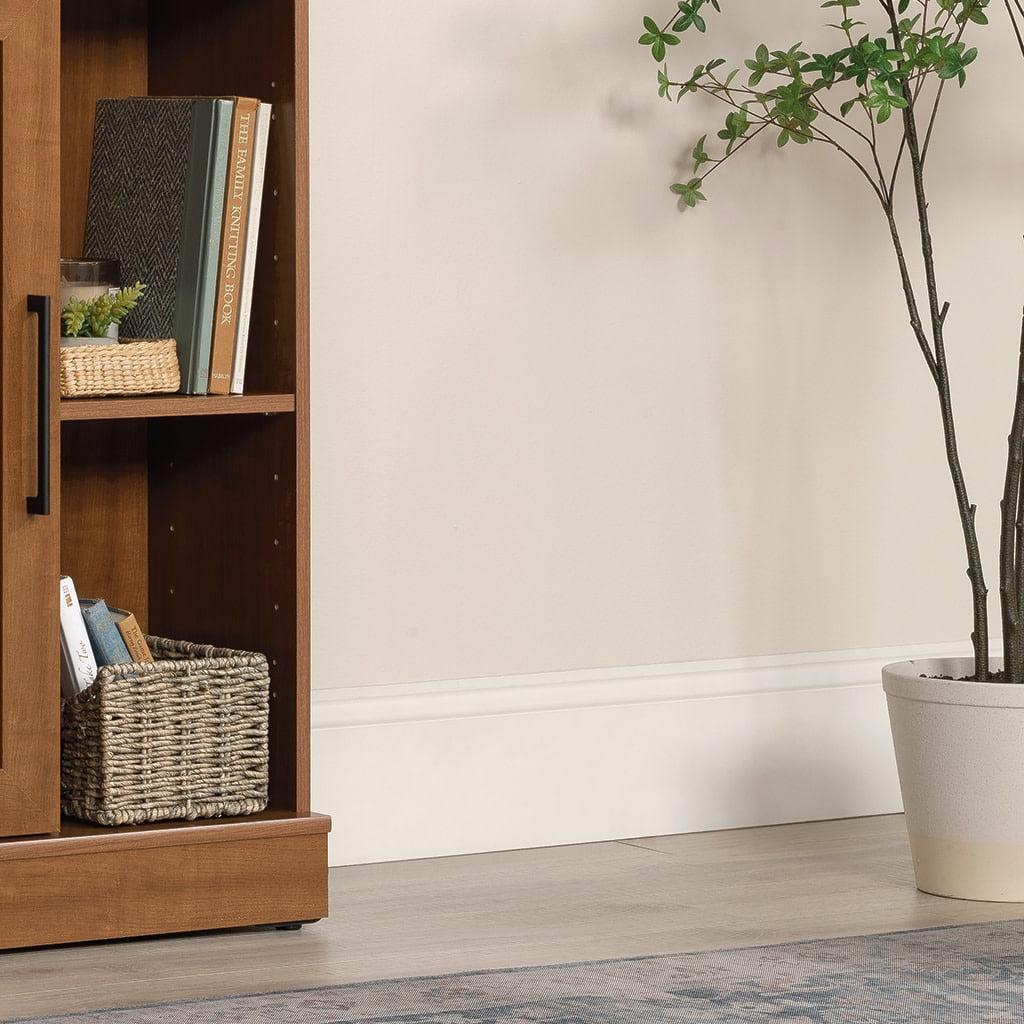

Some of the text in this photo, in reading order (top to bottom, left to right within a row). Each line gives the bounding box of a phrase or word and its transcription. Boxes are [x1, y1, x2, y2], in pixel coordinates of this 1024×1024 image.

[220, 112, 251, 326] THE FAMILY KNITTING BOOK
